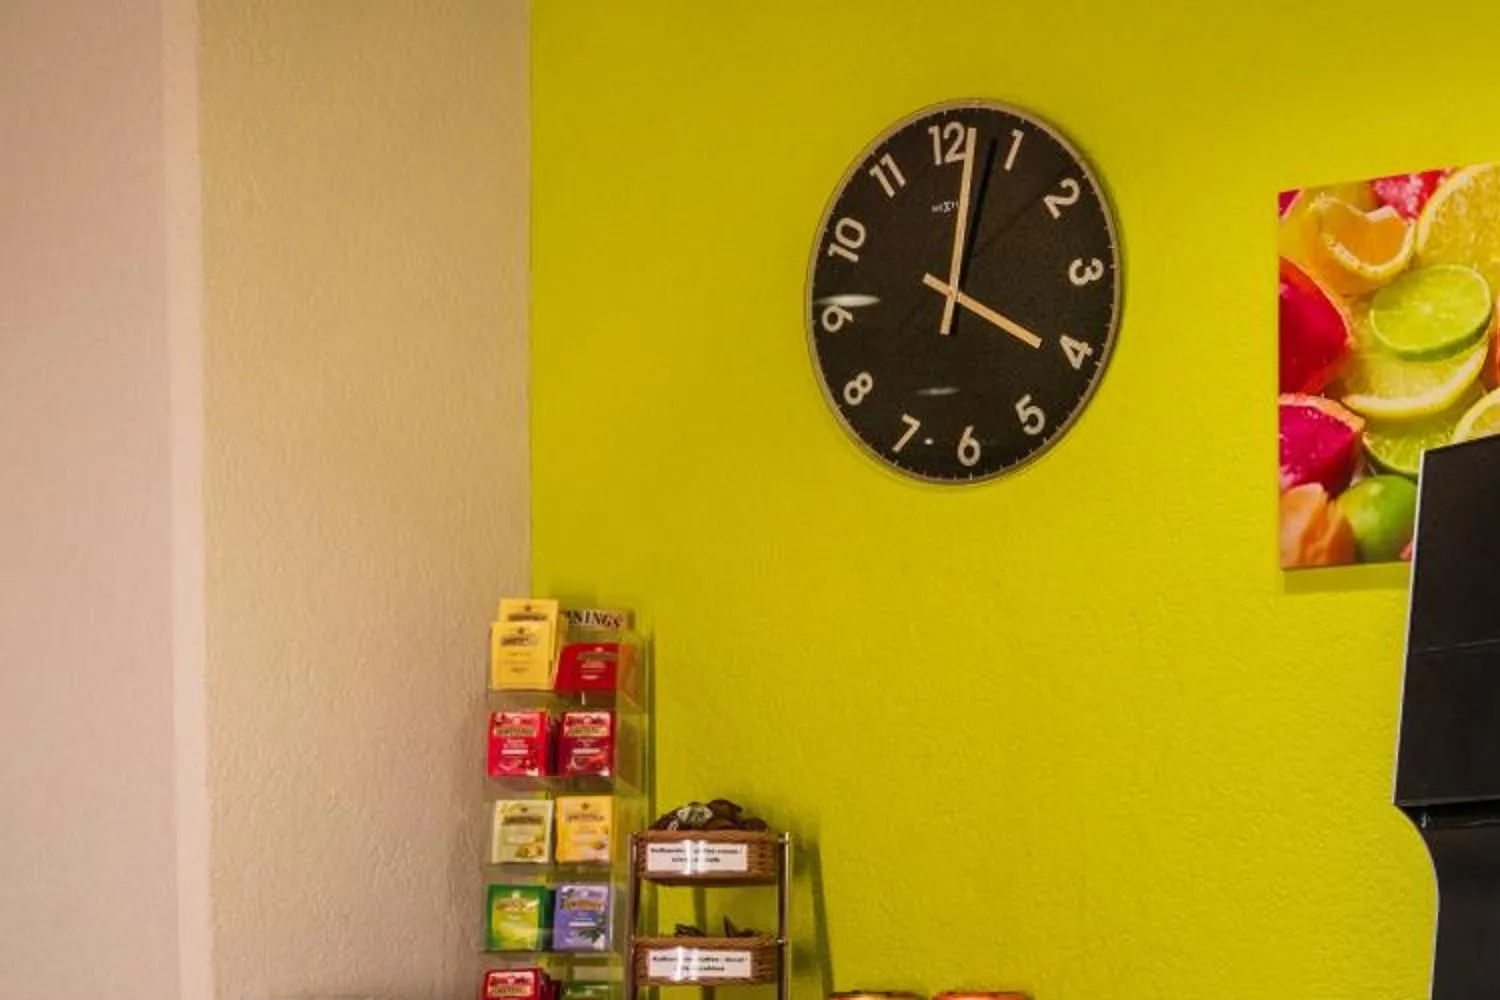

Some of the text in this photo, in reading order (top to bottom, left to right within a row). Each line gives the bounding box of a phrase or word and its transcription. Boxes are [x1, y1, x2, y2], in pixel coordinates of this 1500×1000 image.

[928, 121, 966, 165] 12
[1004, 129, 1024, 170] 1
[869, 153, 906, 198] 11
[1043, 179, 1080, 219] 2
[828, 217, 866, 262] 10
[1069, 257, 1105, 286] 3
[821, 303, 853, 333] 9
[1059, 335, 1093, 370] 4
[843, 372, 873, 406] 8
[892, 413, 920, 453] 7
[1015, 394, 1045, 435] 5
[957, 425, 981, 466] 6
